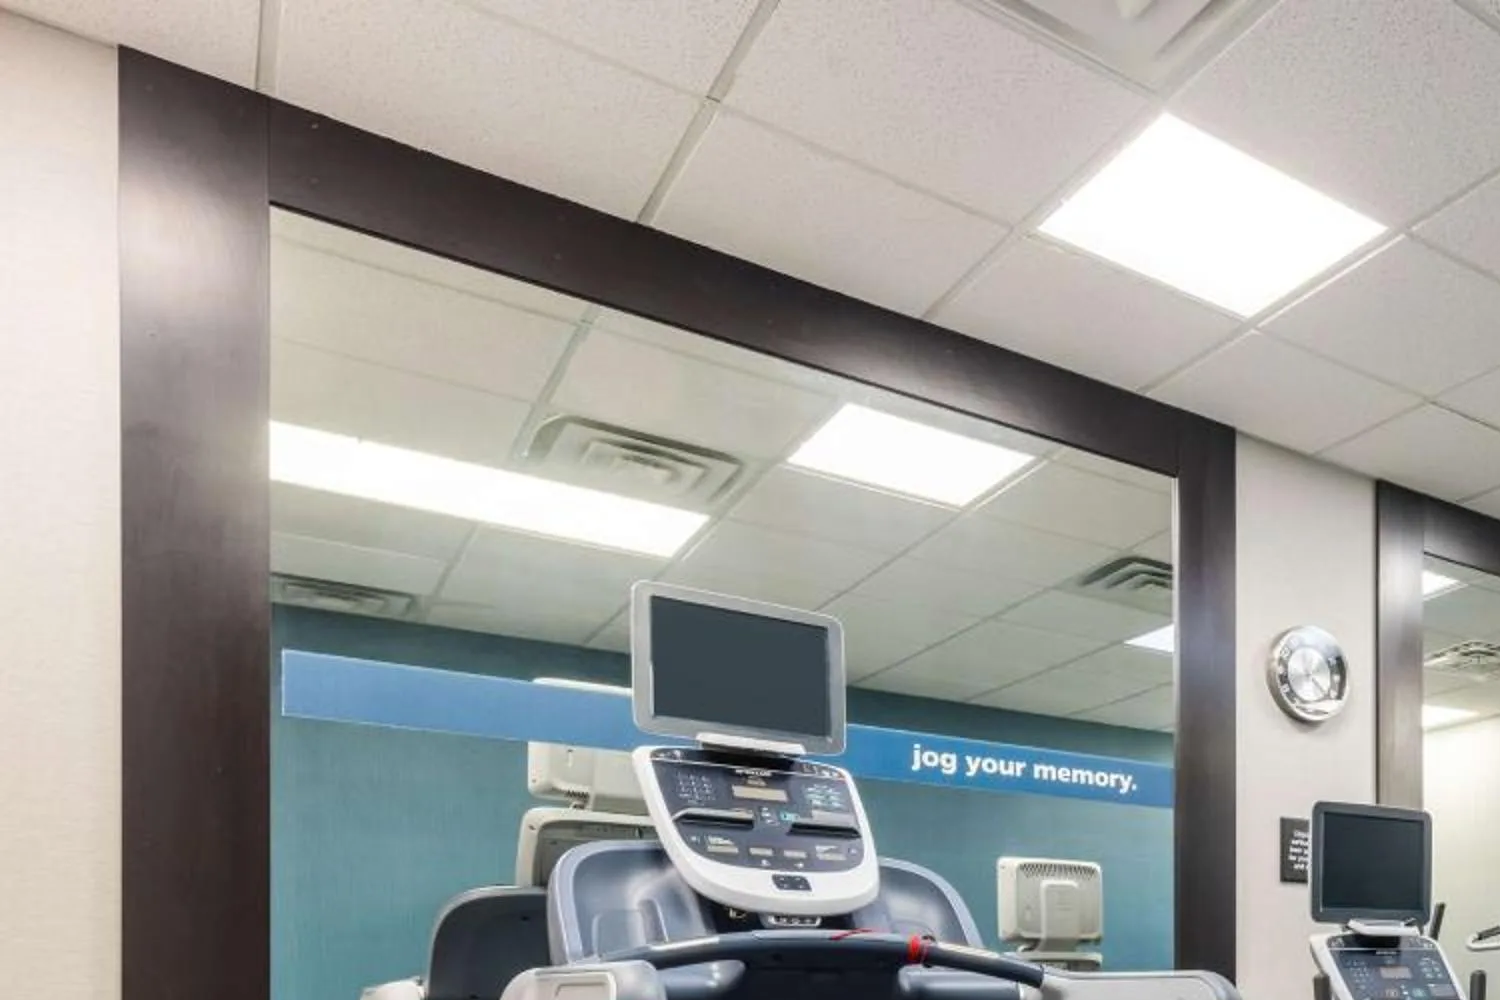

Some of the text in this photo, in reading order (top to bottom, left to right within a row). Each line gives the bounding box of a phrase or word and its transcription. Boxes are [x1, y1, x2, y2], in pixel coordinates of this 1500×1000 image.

[911, 743, 1137, 794] jog your memory.
